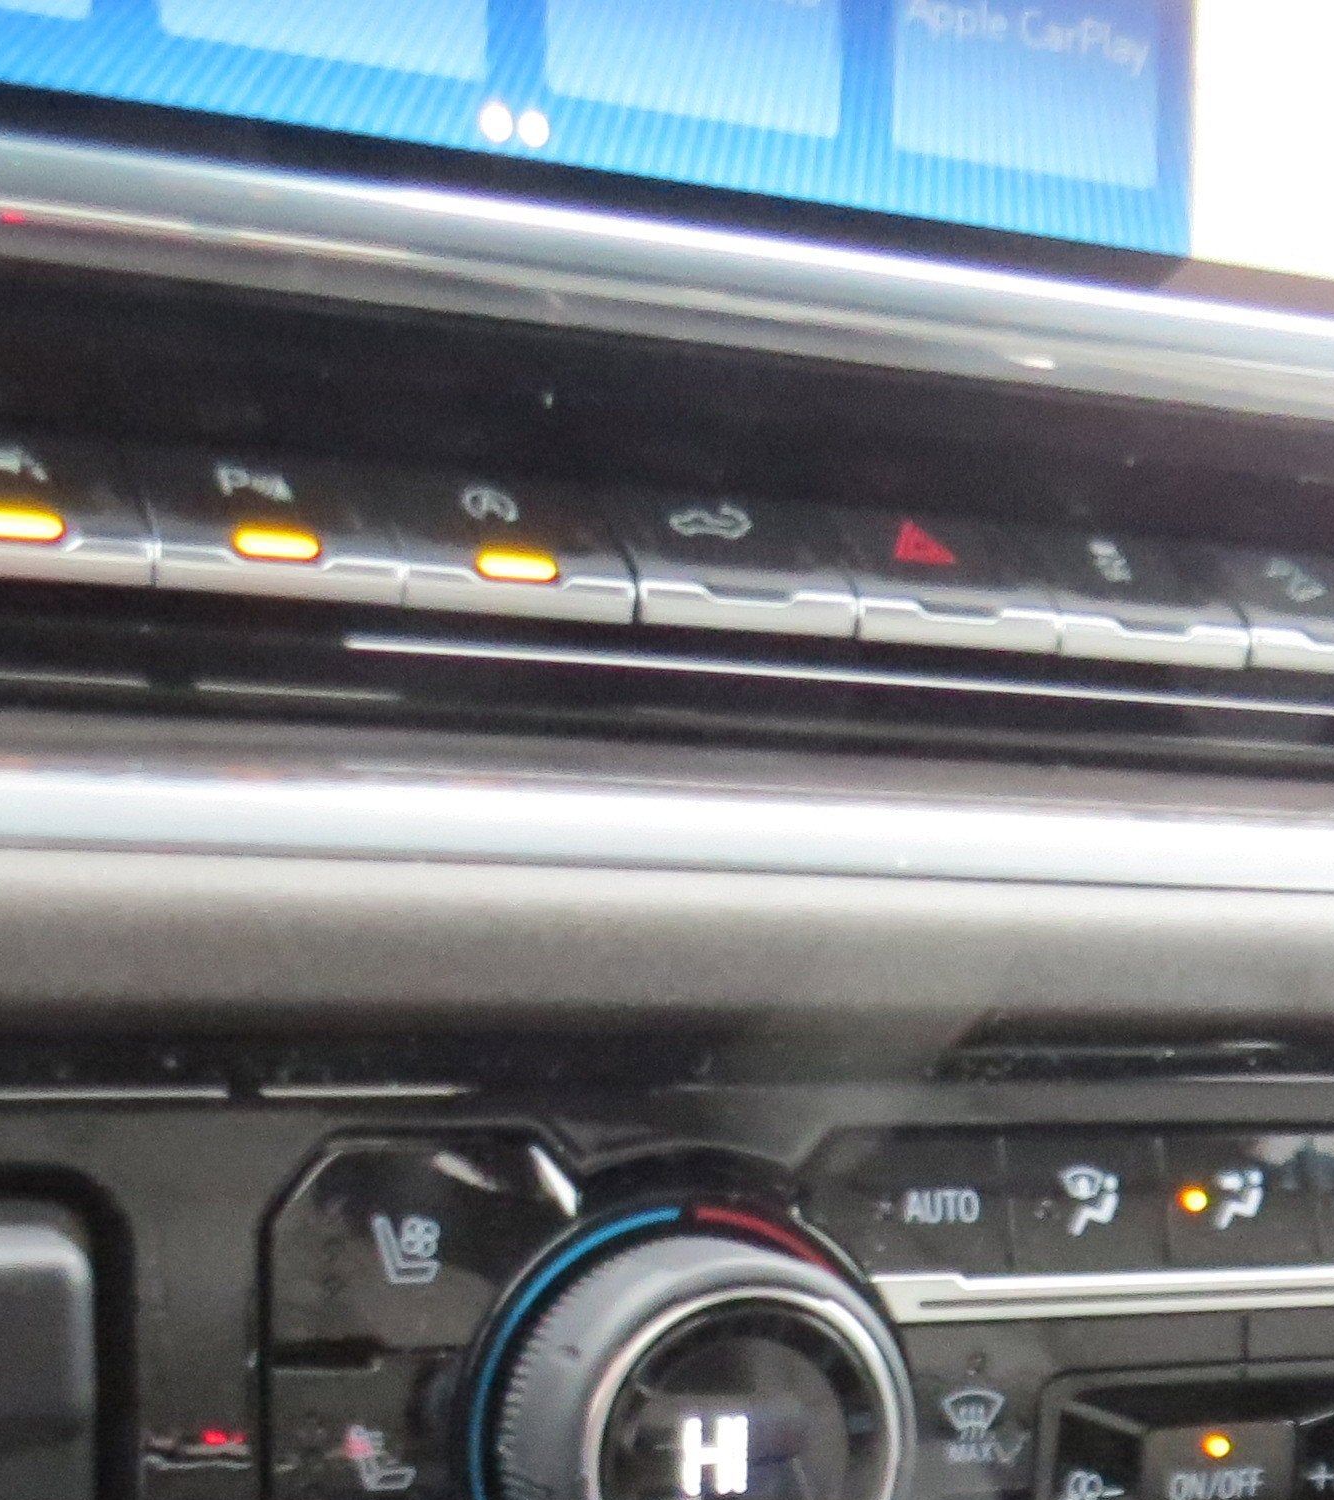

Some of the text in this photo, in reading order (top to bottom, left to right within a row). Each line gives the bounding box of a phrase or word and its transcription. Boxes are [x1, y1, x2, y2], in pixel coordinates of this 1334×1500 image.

[905, 1, 1151, 78] Apple CarPlay
[903, 1187, 980, 1224] AUTO
